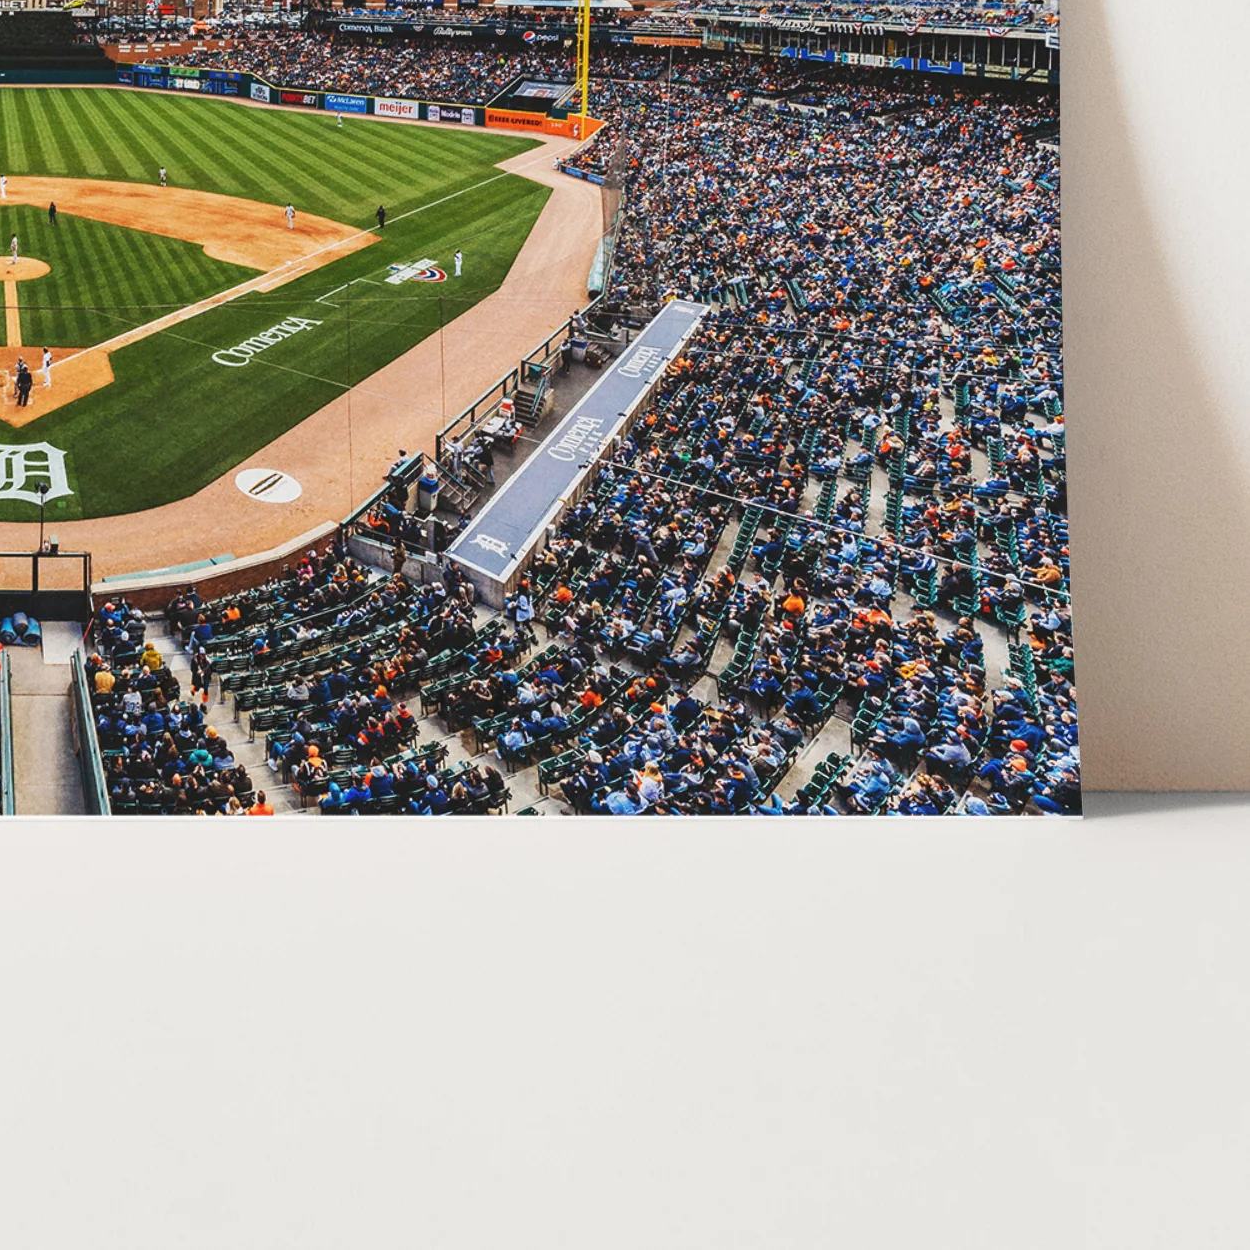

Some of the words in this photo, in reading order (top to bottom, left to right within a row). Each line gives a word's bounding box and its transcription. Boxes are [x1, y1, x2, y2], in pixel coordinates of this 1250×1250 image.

[374, 25, 394, 33] Bank
[536, 33, 559, 42] pepsi
[337, 96, 365, 106] McLaren
[379, 101, 414, 115] meijer
